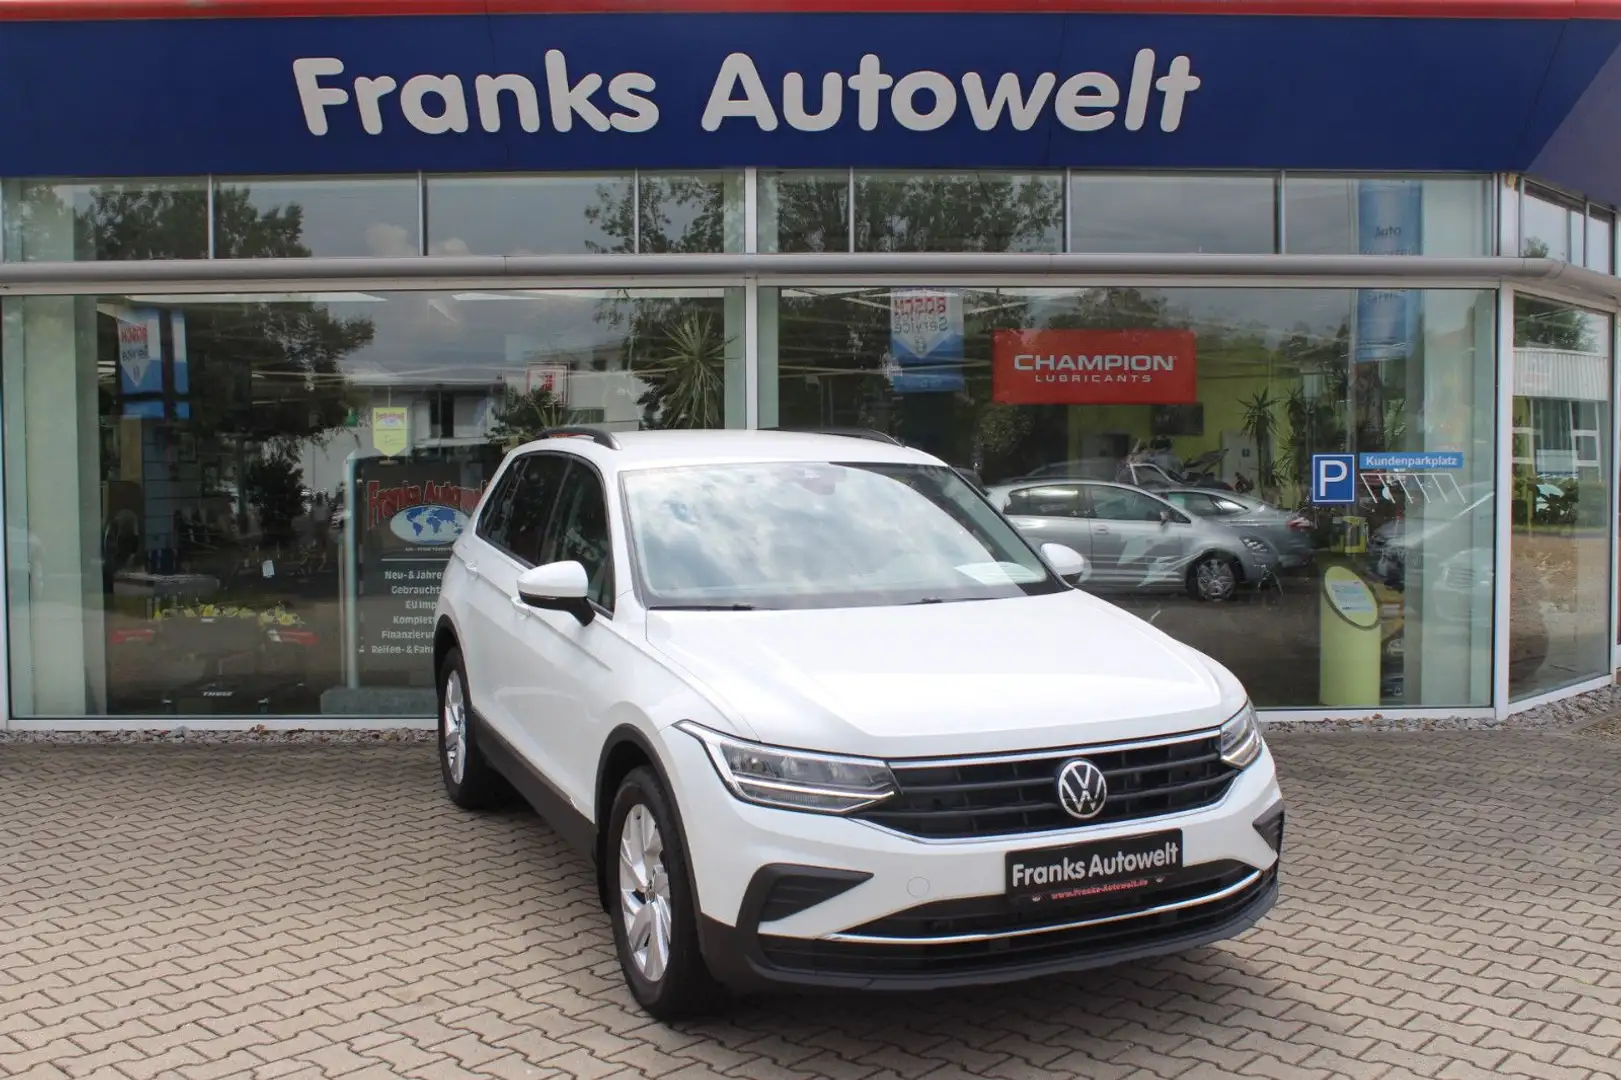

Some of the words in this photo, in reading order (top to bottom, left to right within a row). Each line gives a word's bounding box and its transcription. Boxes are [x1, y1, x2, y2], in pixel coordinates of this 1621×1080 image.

[292, 49, 660, 136] Franks
[701, 48, 1201, 133] Autowelt
[1013, 354, 1174, 371] CHAMPION
[1034, 374, 1153, 383] LUBRICANTS
[1365, 455, 1458, 467] Kundenparkplatz
[1319, 460, 1348, 497] P
[1012, 857, 1086, 888] Franks
[1088, 841, 1179, 877] Autowelt
